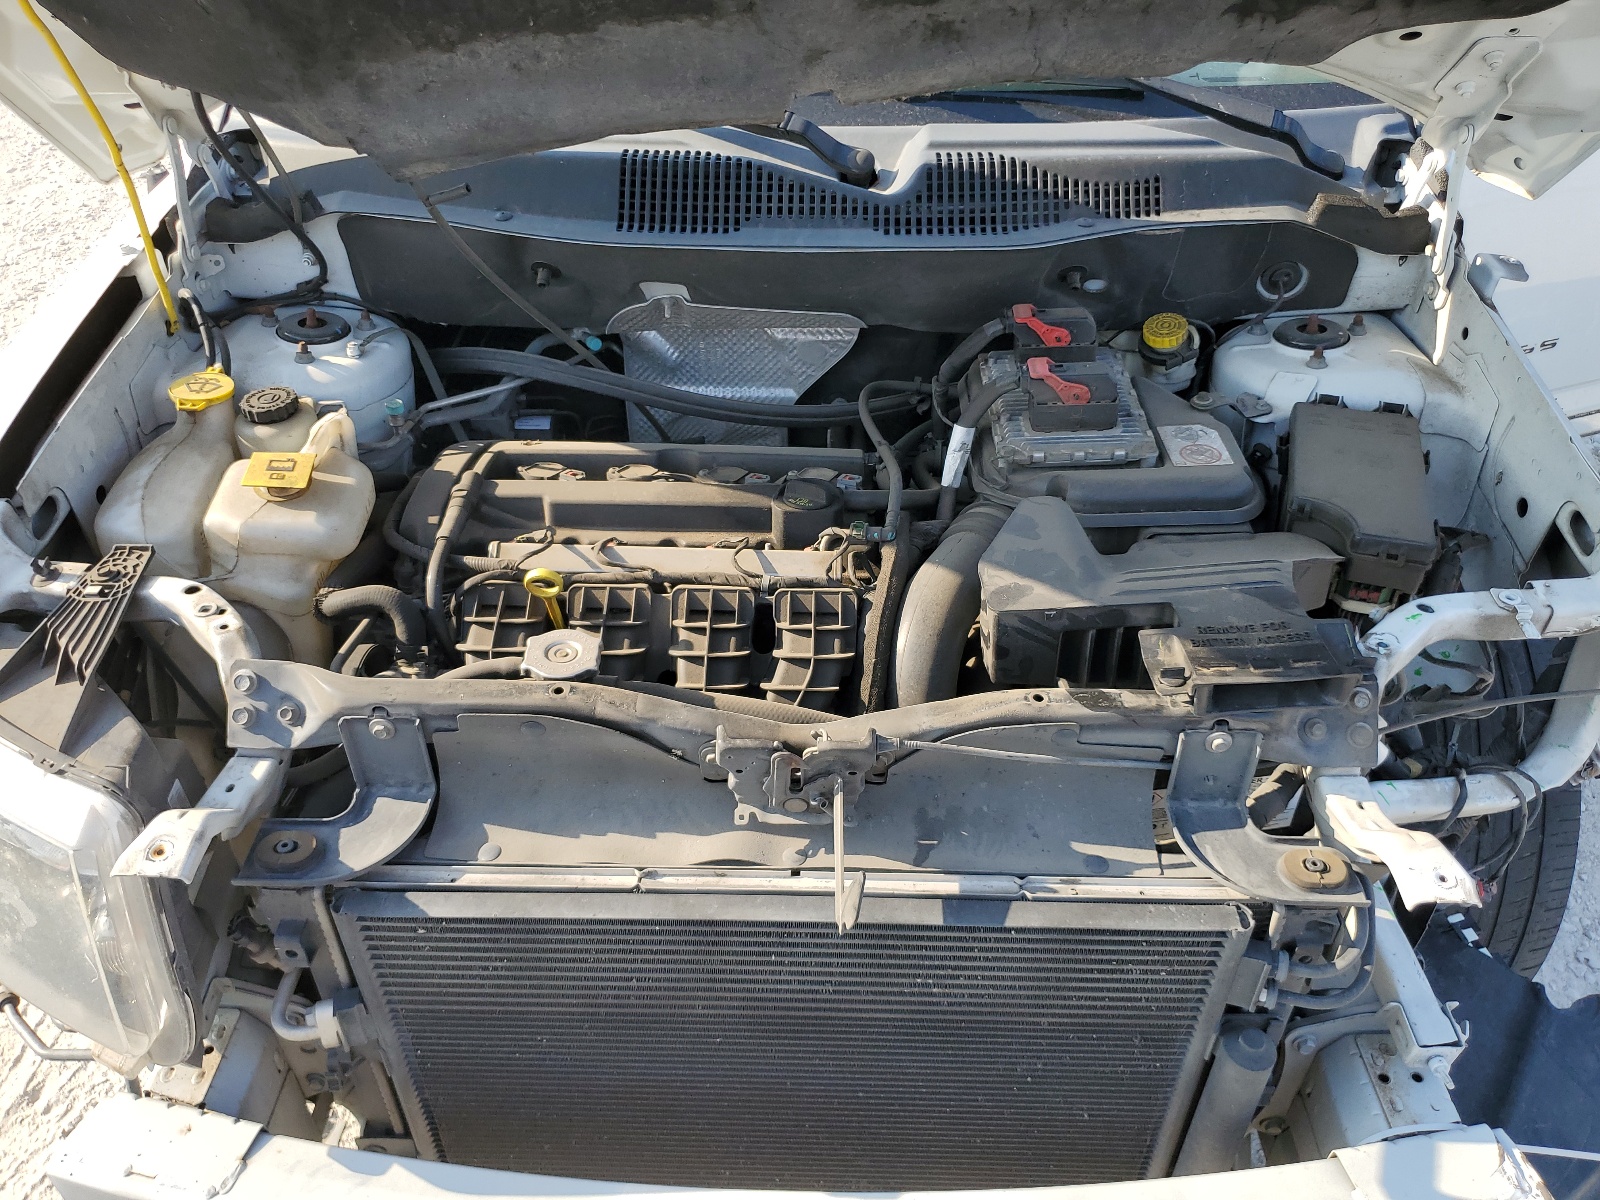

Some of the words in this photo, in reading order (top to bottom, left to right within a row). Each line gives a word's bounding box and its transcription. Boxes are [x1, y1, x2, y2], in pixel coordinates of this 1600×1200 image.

[1196, 623, 1258, 635] REMOVE
[1260, 620, 1291, 633] FOR
[1257, 631, 1314, 645] ACCESS
